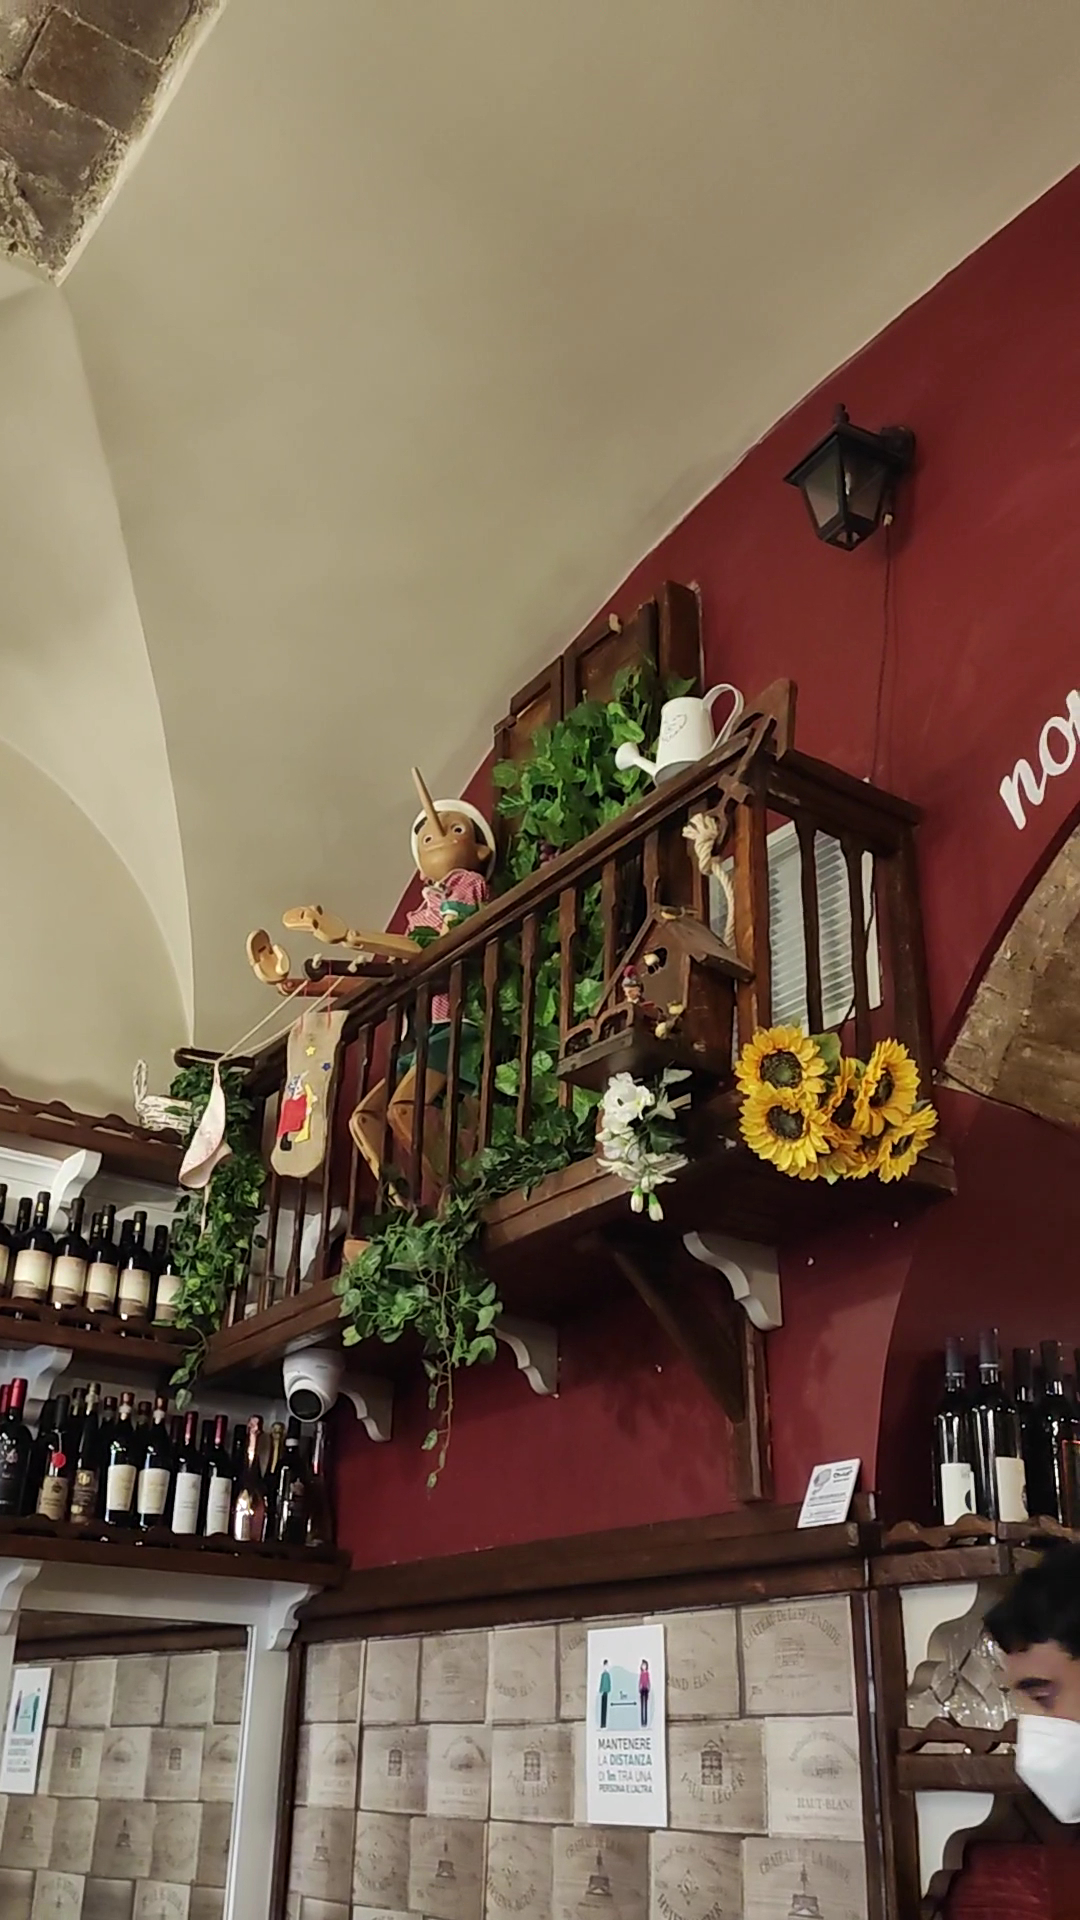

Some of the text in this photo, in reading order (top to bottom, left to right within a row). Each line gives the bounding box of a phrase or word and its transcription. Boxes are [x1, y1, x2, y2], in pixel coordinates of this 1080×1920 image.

[597, 1737, 651, 1750] MANTENERE
[597, 1753, 652, 1766] LA DISTANZA
[598, 1770, 605, 1781] DI
[618, 1769, 634, 1781] TRA
[634, 1769, 652, 1782] UNA
[598, 1783, 625, 1793] PERSONA
